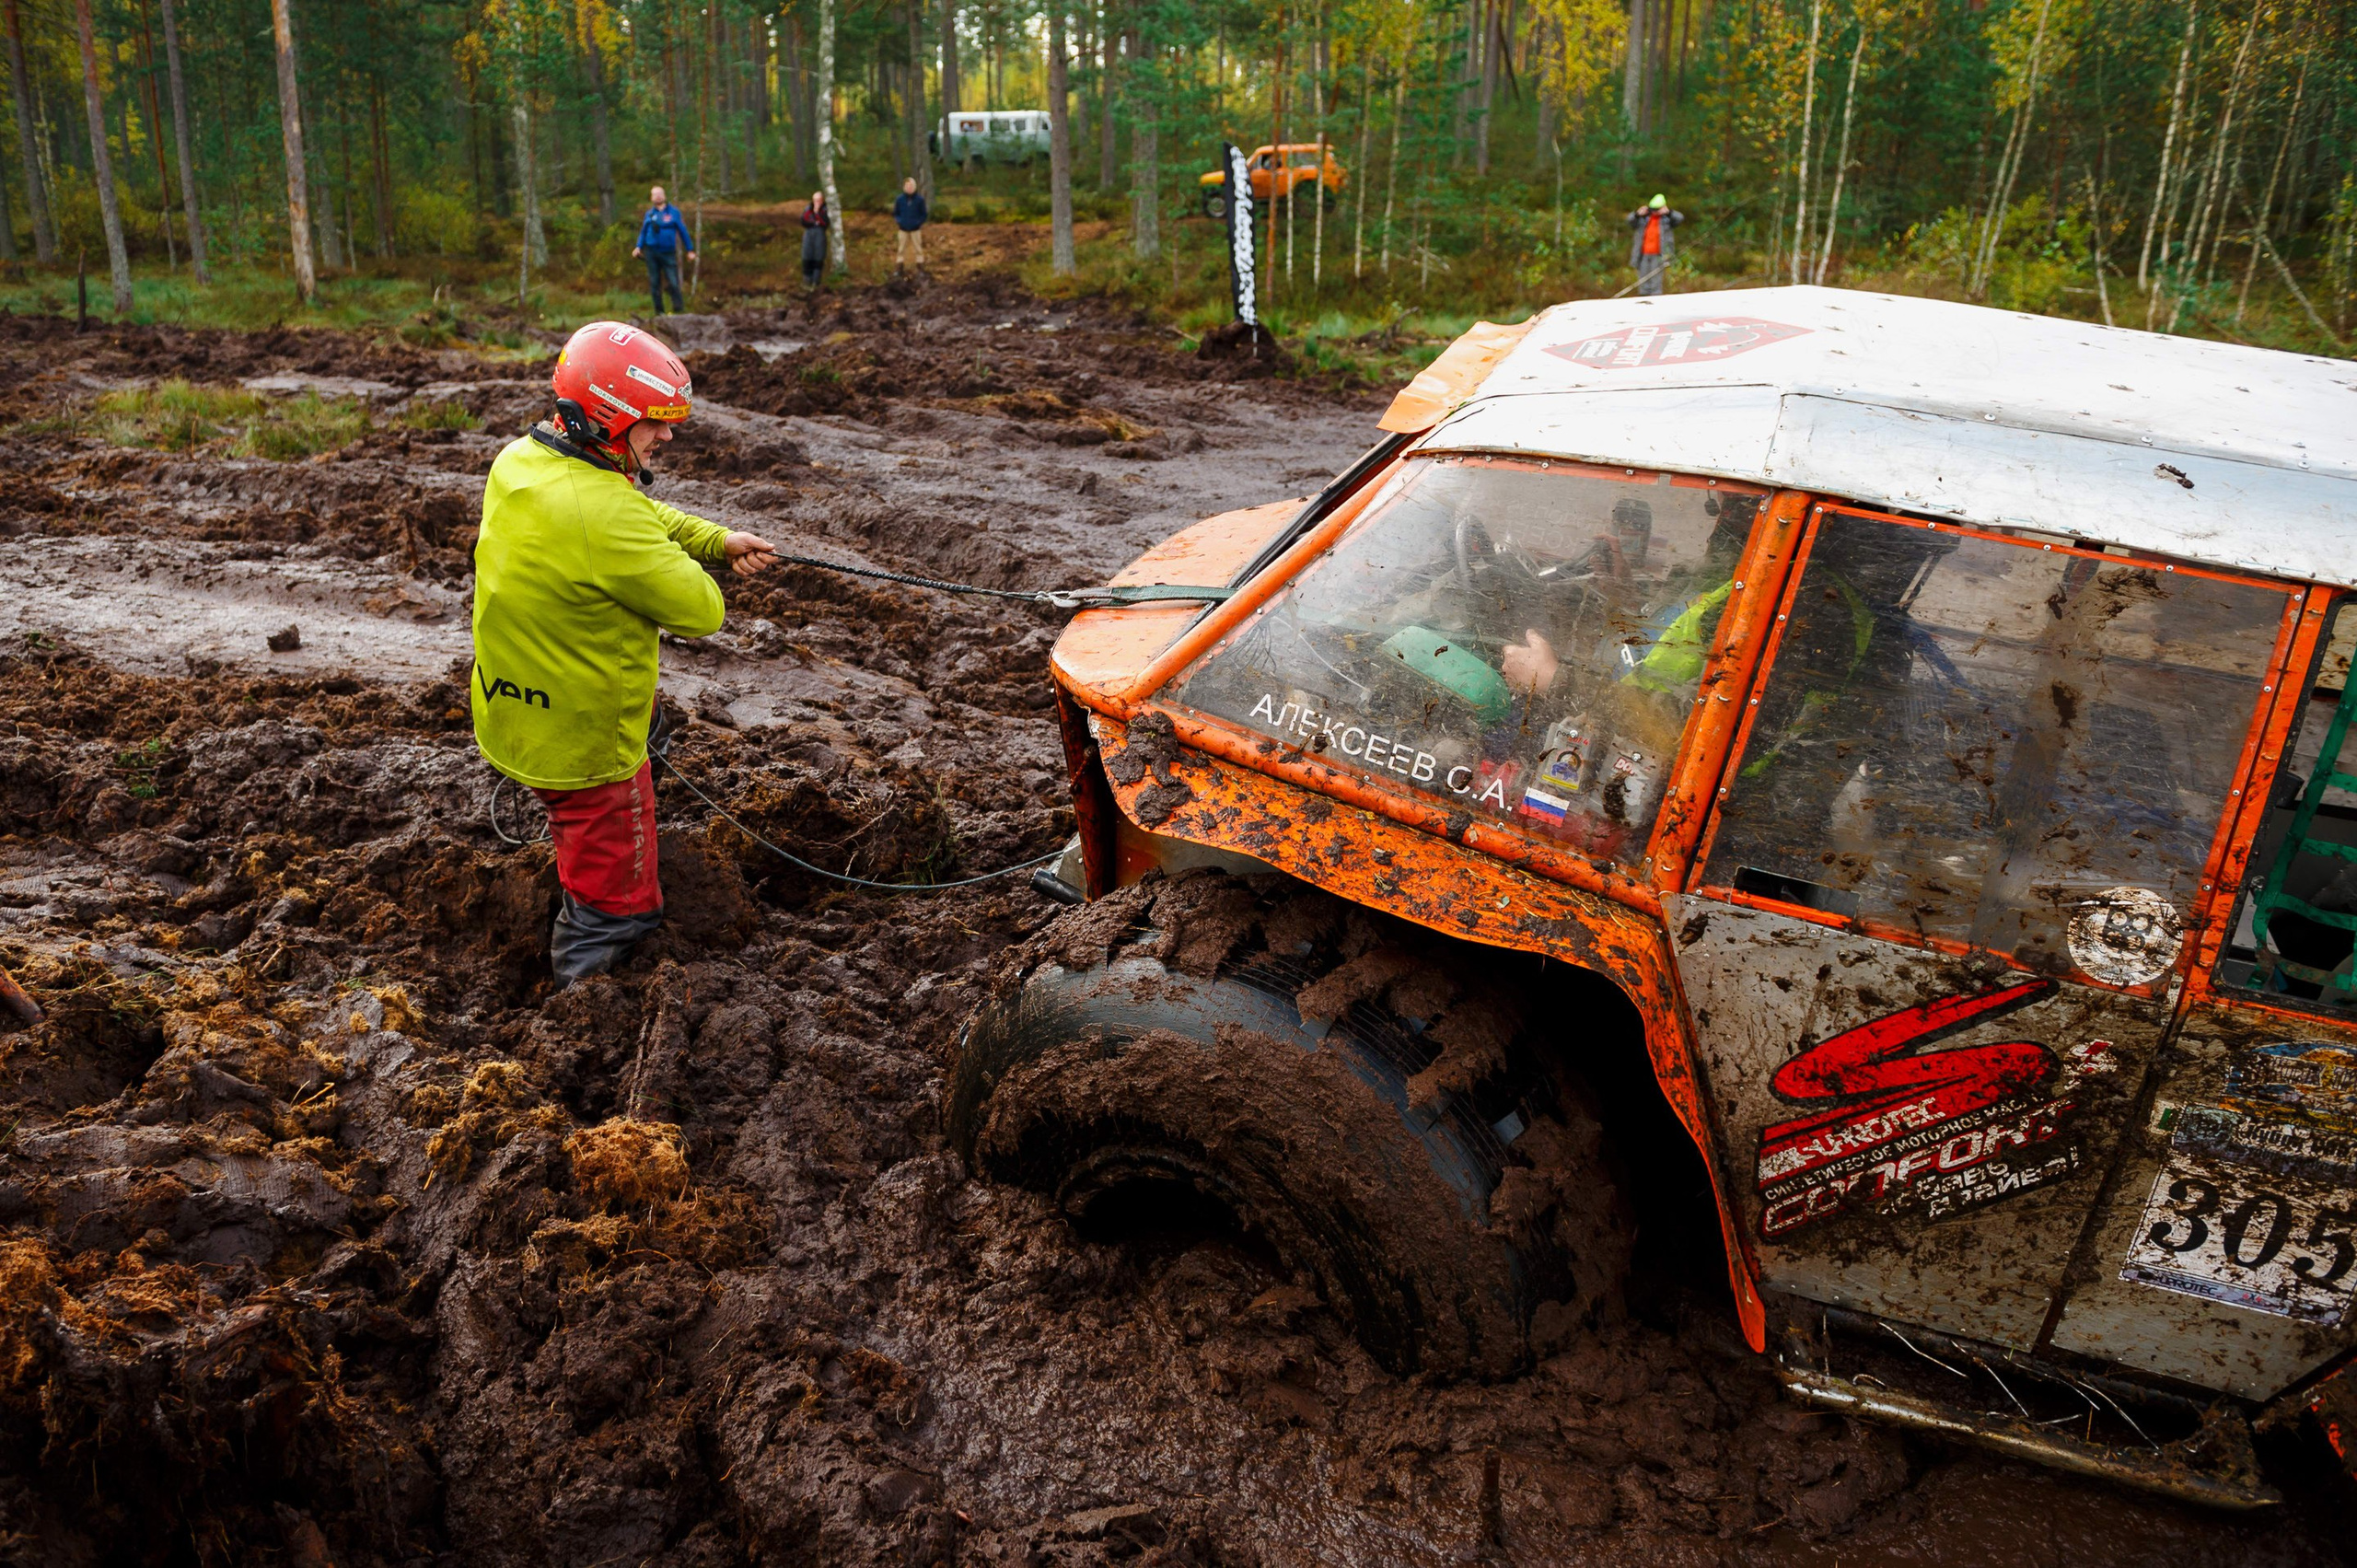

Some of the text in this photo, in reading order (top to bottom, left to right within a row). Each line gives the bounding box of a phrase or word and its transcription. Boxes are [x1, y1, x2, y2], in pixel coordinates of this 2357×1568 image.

[1248, 693, 1437, 782] АЛЕКСЕЕВ
[1765, 1145, 1893, 1201] СИНЕТИЧЕСОЕ
[2150, 1178, 2356, 1281] 305
